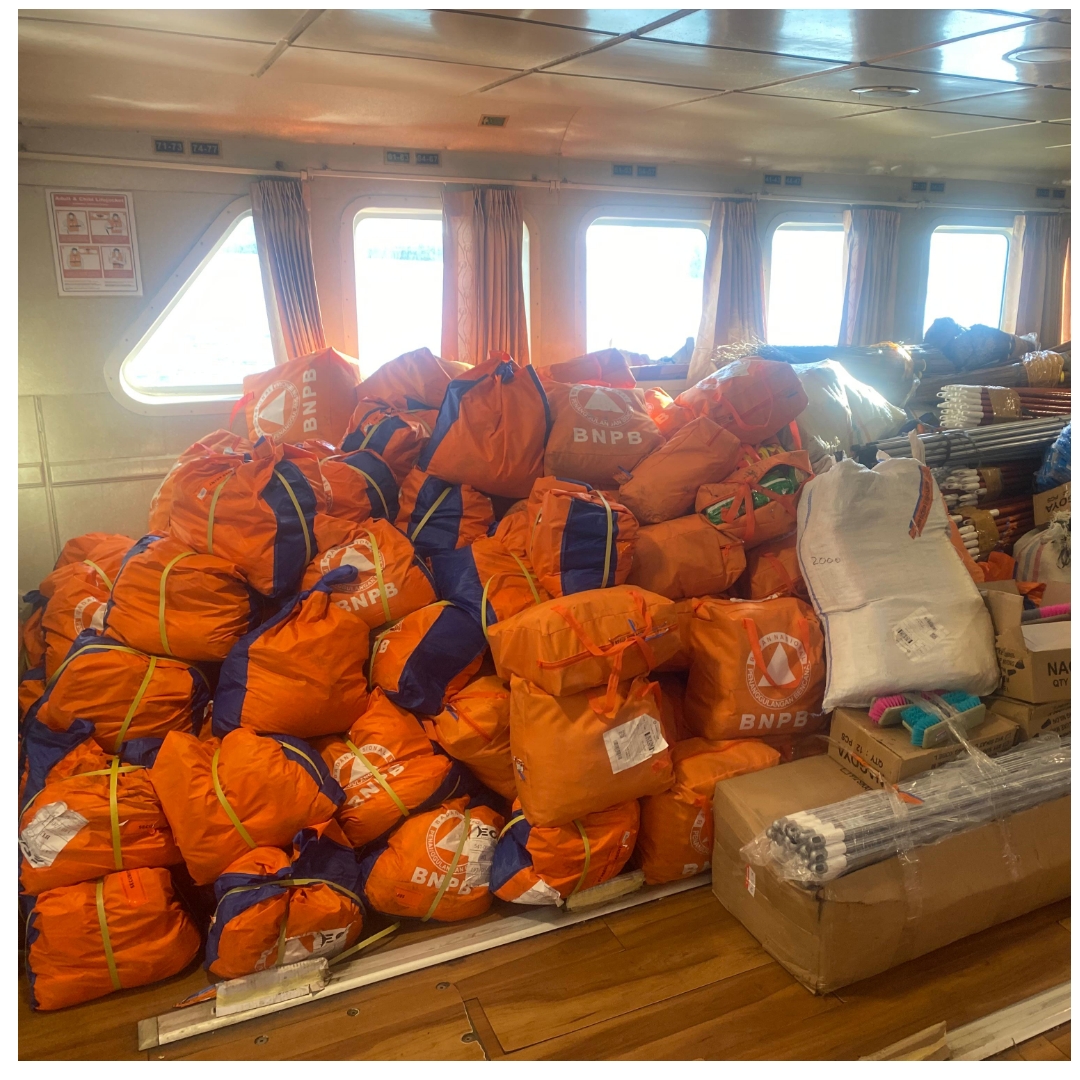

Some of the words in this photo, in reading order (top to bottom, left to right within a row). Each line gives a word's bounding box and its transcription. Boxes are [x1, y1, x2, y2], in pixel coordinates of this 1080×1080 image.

[155, 141, 183, 152] 71-73
[191, 143, 218, 155] 74-77
[302, 368, 318, 433] BNPB
[573, 427, 643, 445] BNPB
[811, 555, 841, 566] 2000
[1047, 660, 1071, 677] NA
[1052, 677, 1069, 688] QTY
[739, 710, 809, 731] BNPB
[840, 732, 853, 748] PCS
[855, 742, 864, 753] 12
[870, 751, 884, 768] QTY
